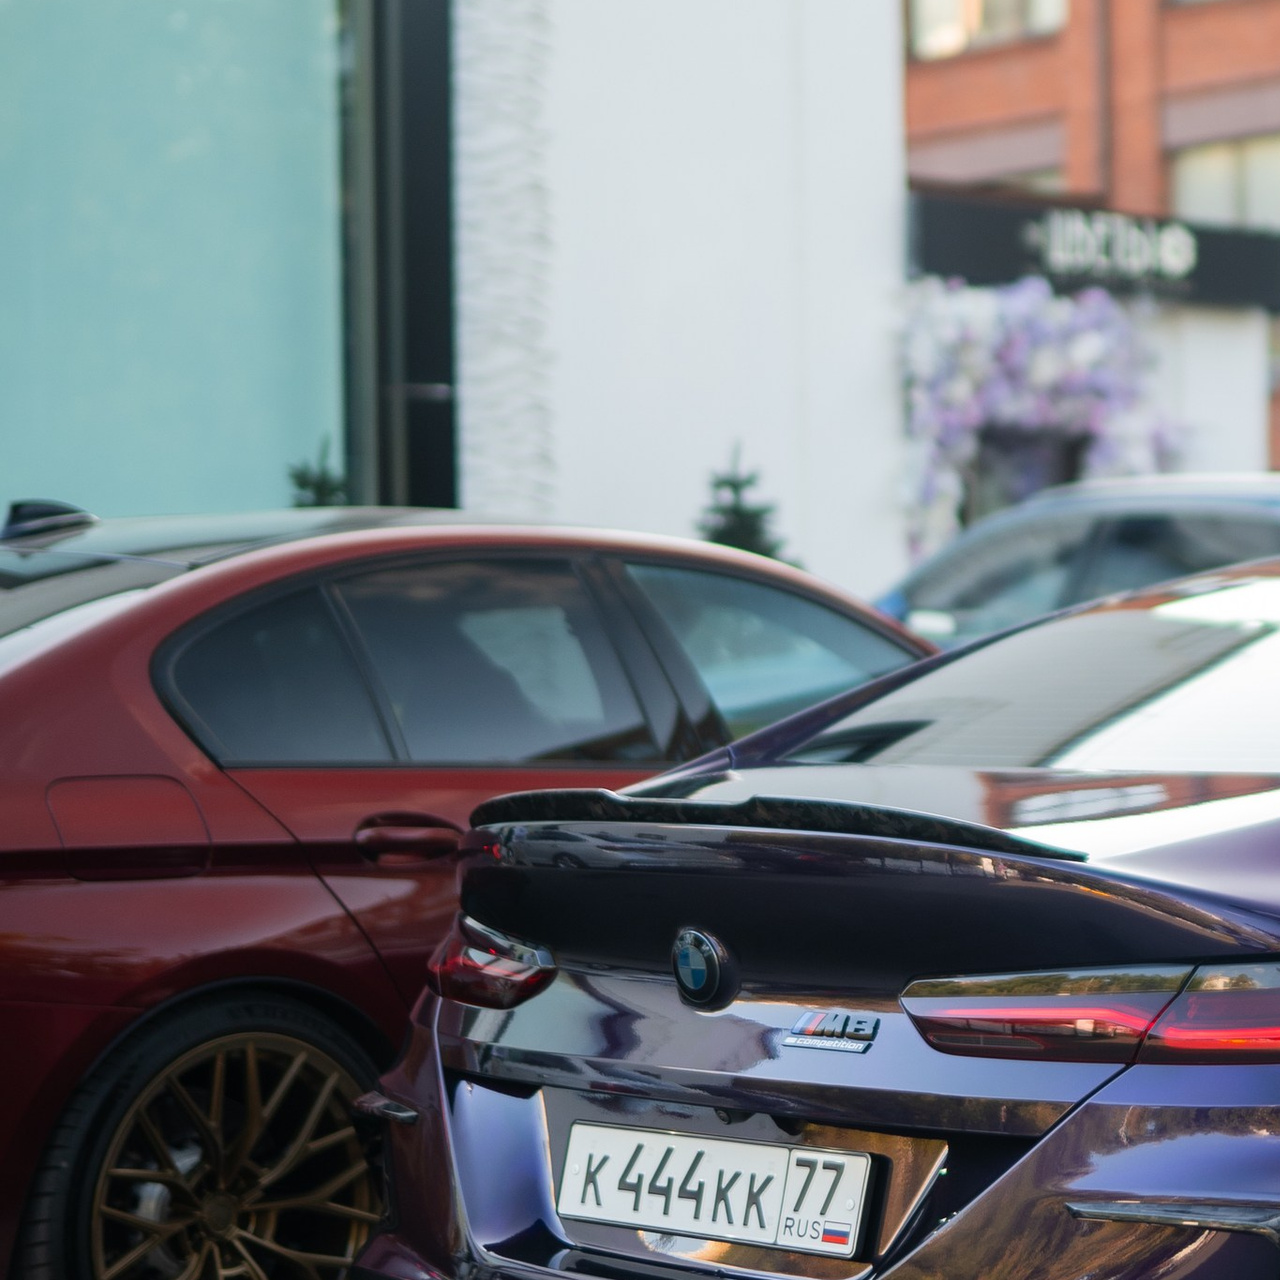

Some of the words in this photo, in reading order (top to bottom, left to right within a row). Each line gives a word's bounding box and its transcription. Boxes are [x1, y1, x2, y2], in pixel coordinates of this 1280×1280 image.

[812, 1012, 881, 1041] M8
[796, 1037, 864, 1051] competition
[793, 1156, 846, 1216] 77
[782, 1216, 821, 1240] RUS
